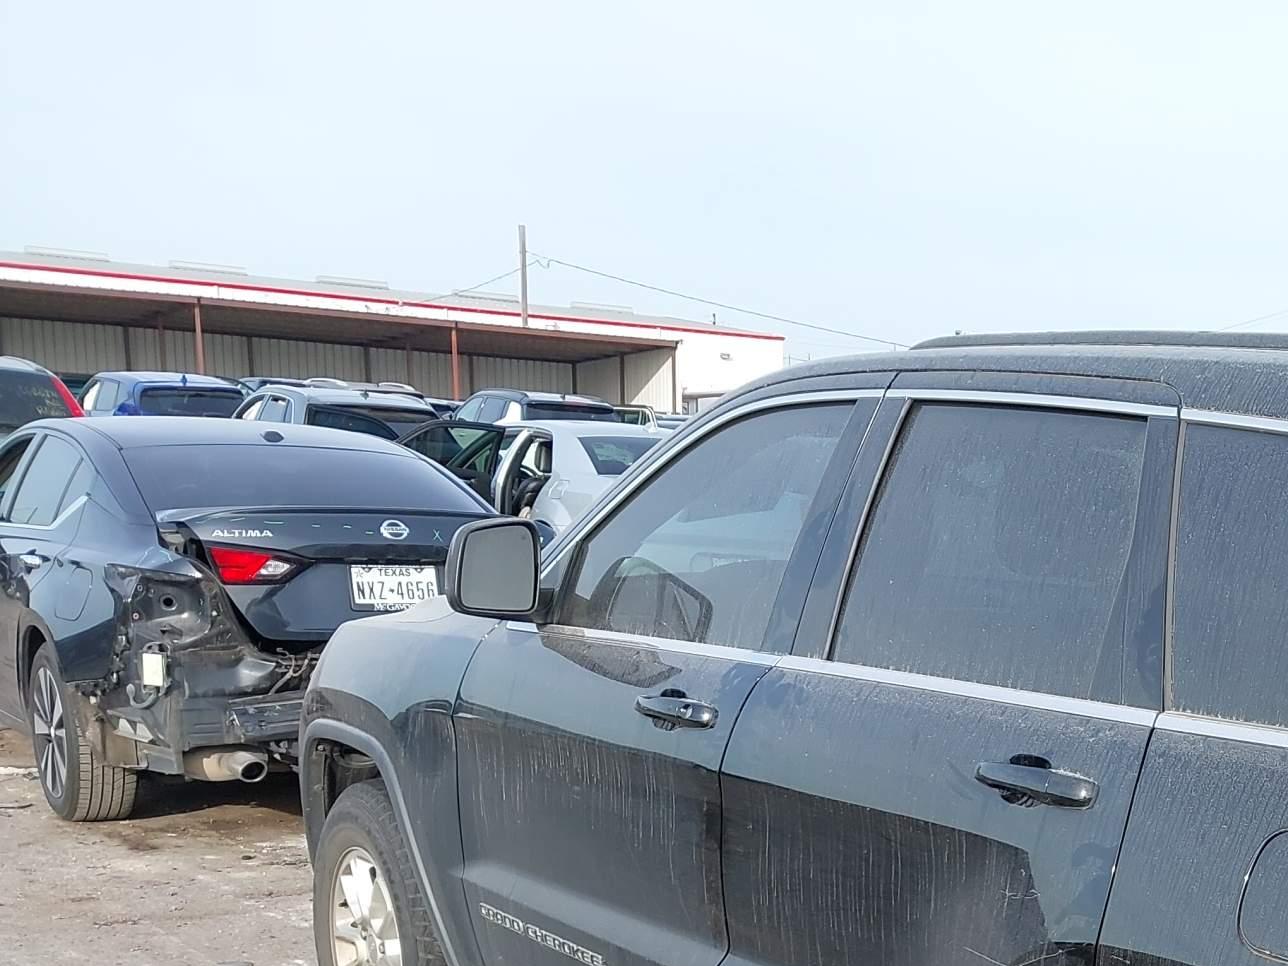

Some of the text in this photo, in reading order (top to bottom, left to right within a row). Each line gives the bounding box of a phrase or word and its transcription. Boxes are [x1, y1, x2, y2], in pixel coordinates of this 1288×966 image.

[211, 529, 274, 538] ALTIMA
[377, 568, 412, 577] TEXAS
[479, 902, 525, 936] GRAND
